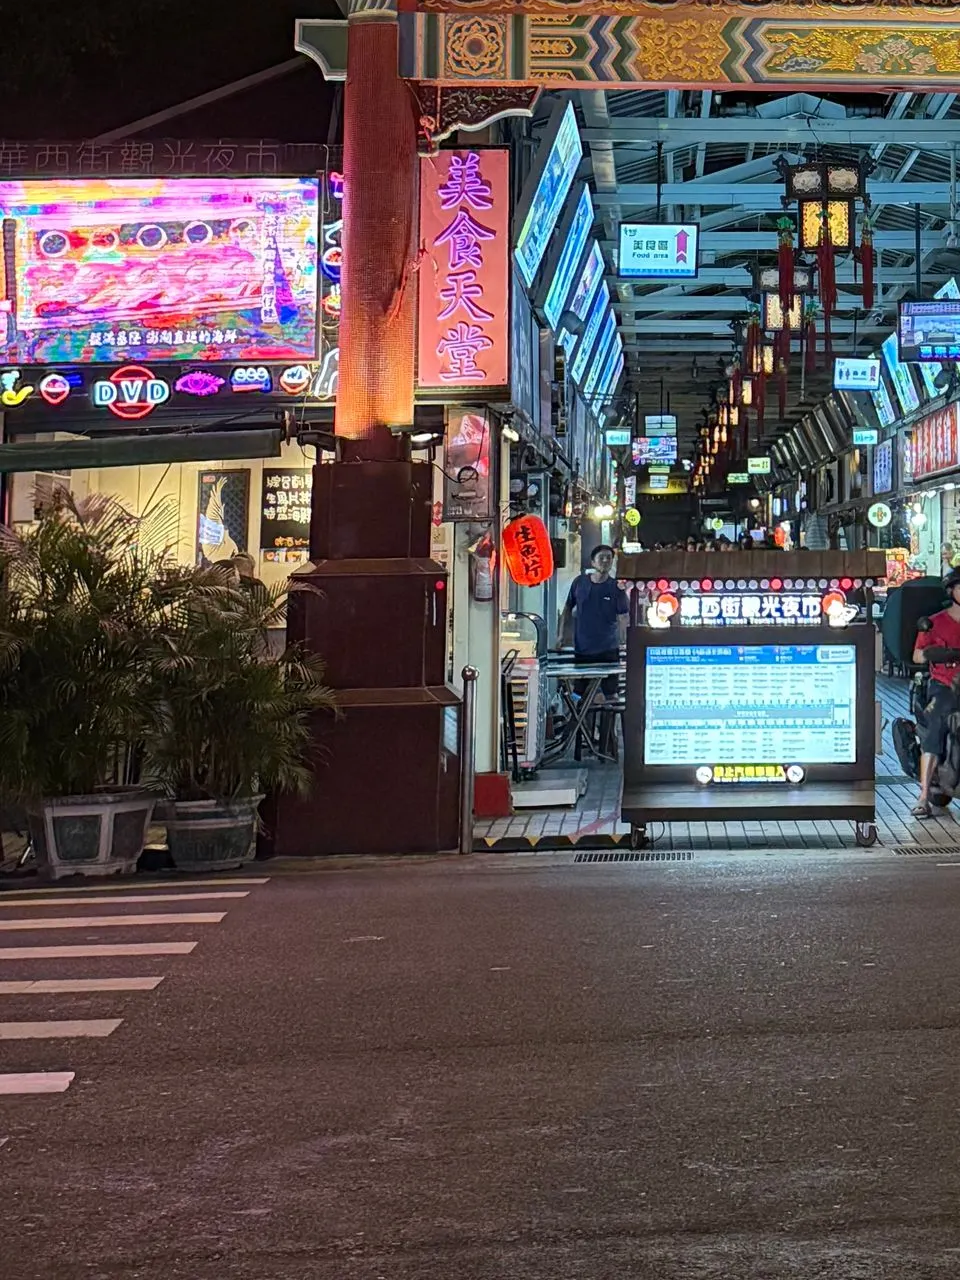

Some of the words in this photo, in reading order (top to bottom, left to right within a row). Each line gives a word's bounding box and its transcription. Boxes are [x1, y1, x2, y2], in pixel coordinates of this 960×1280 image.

[0, 140, 279, 174] 華西街觀光夜市
[633, 240, 668, 250] 美食區
[434, 153, 496, 382] 美食天堂
[95, 380, 170, 405] DVD
[515, 525, 542, 578] 生魚片
[680, 595, 822, 618] 華西街觀光夜市
